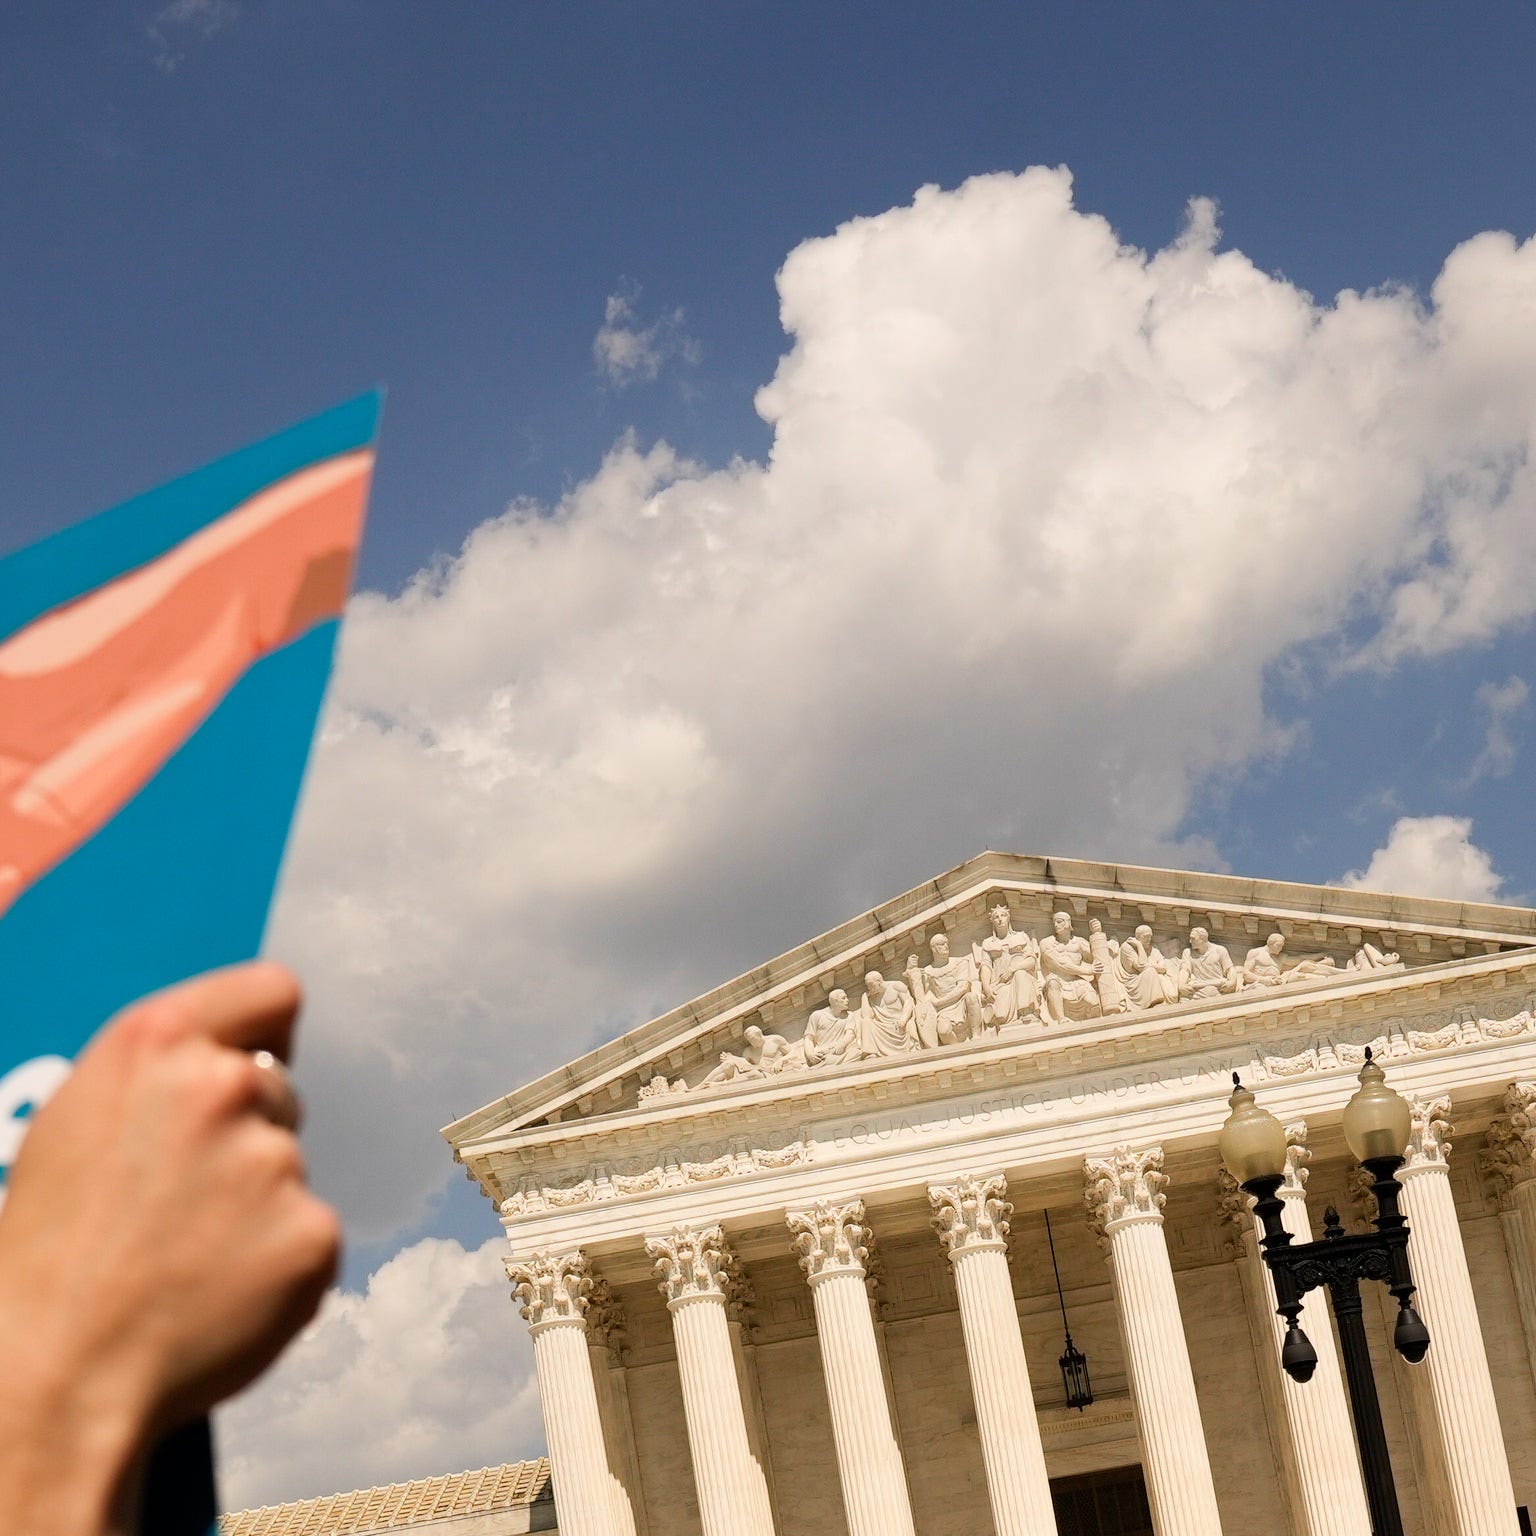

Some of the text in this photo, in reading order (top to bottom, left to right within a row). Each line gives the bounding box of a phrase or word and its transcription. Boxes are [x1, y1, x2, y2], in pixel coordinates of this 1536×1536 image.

[833, 1056, 1235, 1149] EQUAL JUSTICE UNDER LAW
